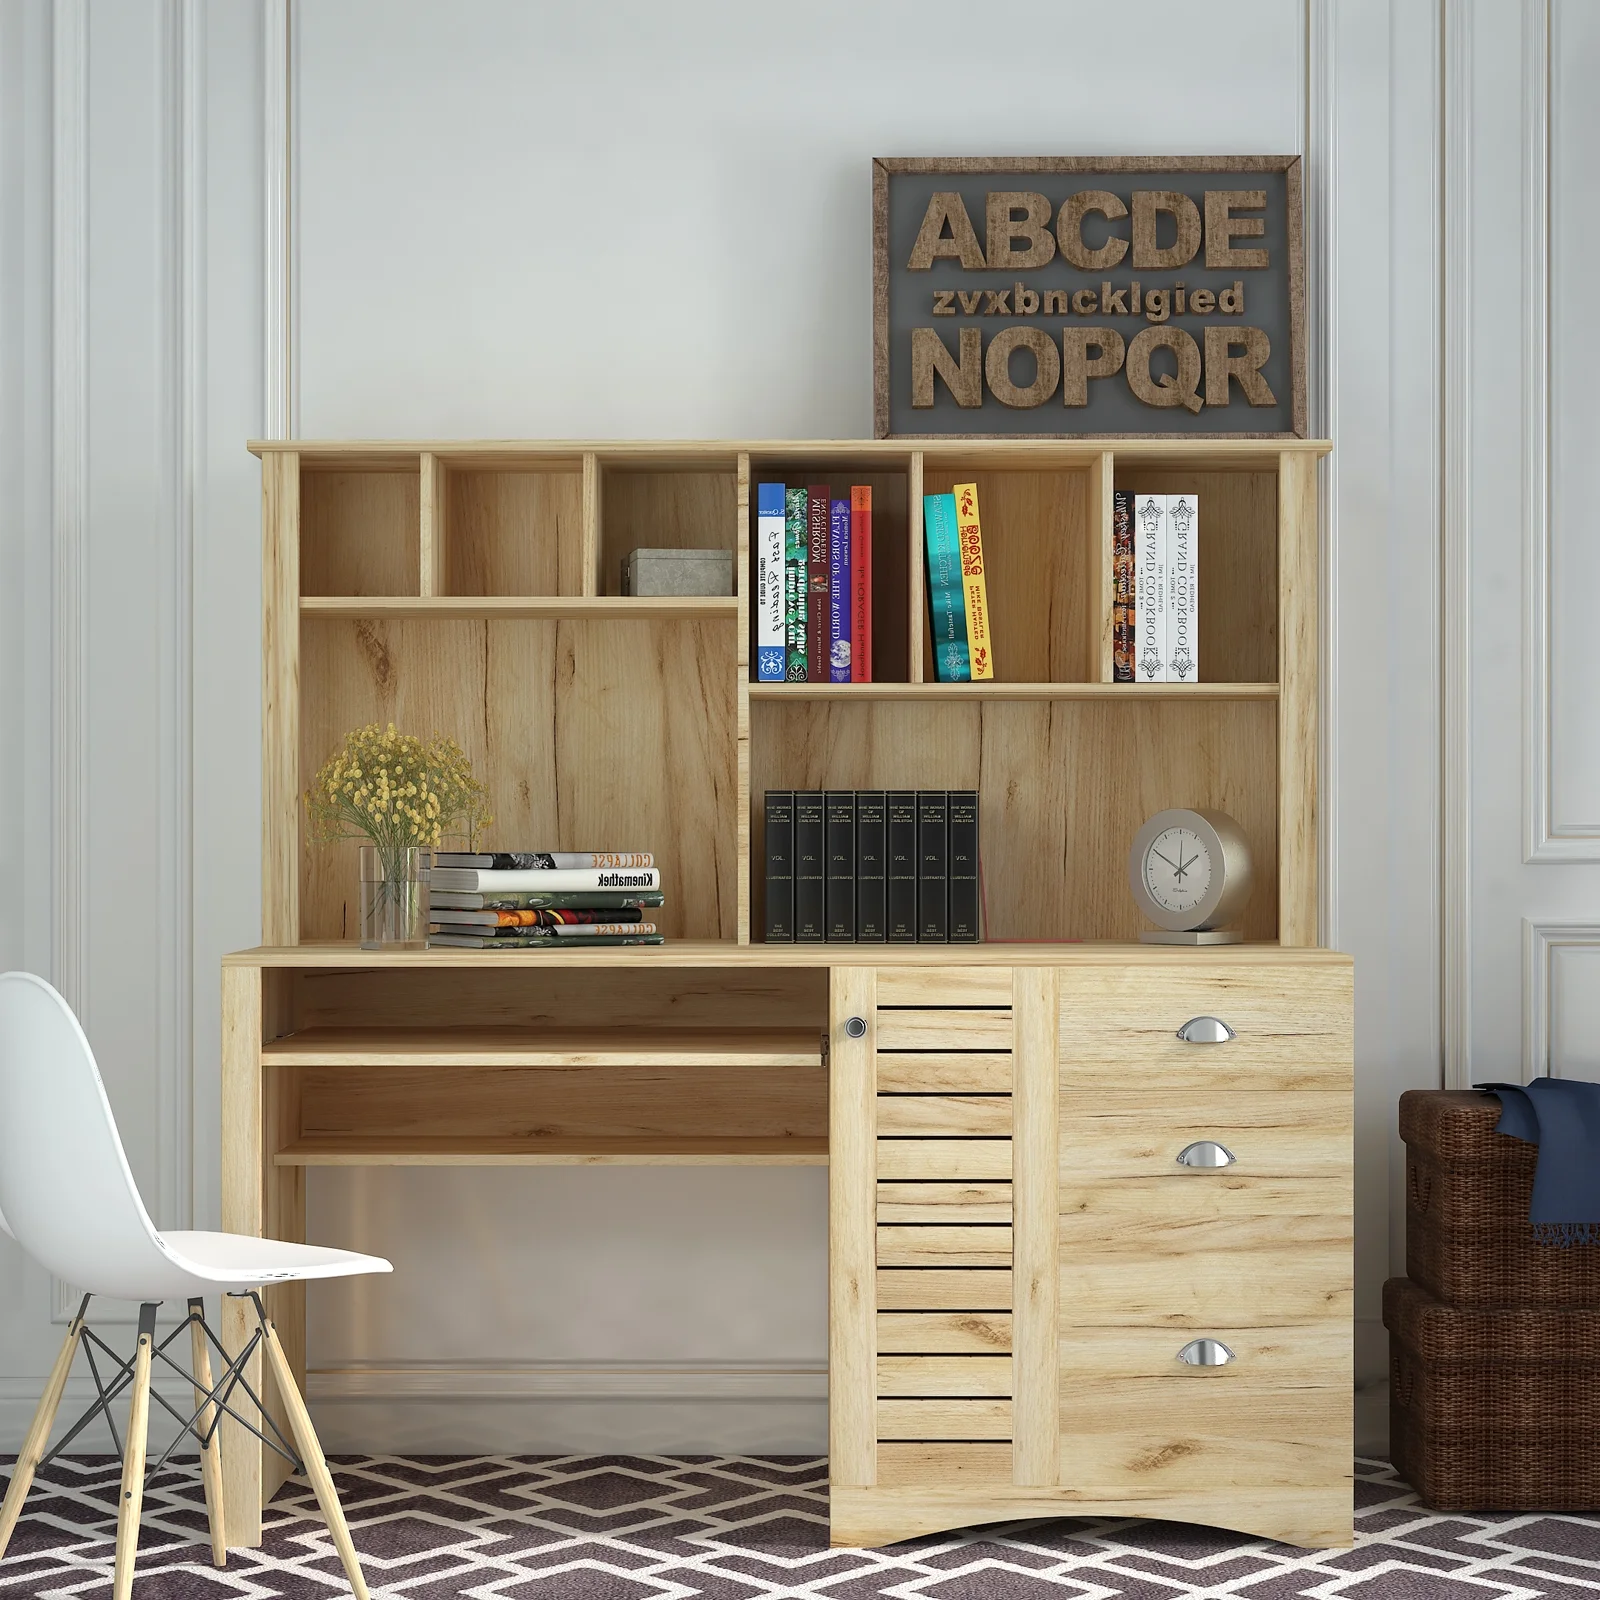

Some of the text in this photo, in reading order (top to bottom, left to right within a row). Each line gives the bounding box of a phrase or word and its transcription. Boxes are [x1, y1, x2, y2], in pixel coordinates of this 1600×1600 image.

[907, 190, 1269, 272] ABCDE
[933, 281, 1244, 324] zvxbncklgied
[911, 325, 1277, 416] NOPQR
